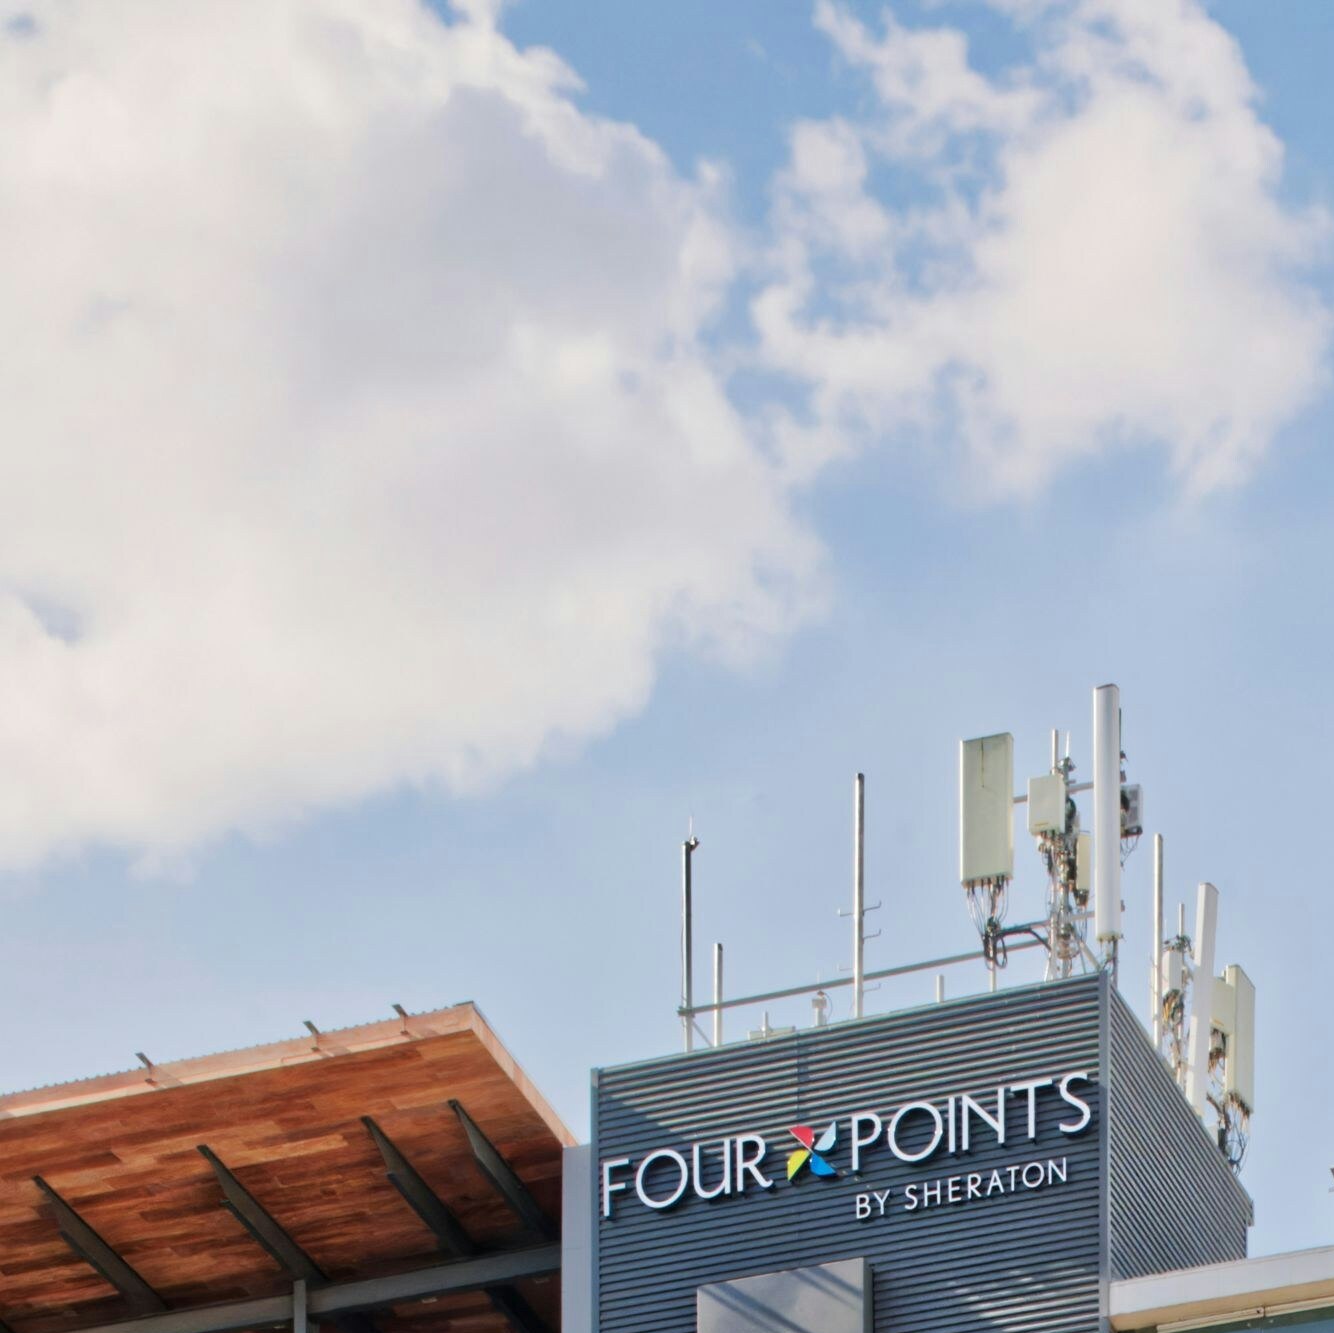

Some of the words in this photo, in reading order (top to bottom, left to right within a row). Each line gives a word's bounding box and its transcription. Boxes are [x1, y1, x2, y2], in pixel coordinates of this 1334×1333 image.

[602, 1134, 774, 1218] FOUR
[850, 1072, 1092, 1172] POINTS
[855, 1189, 891, 1220] BY
[904, 1157, 1068, 1211] SHERATON
